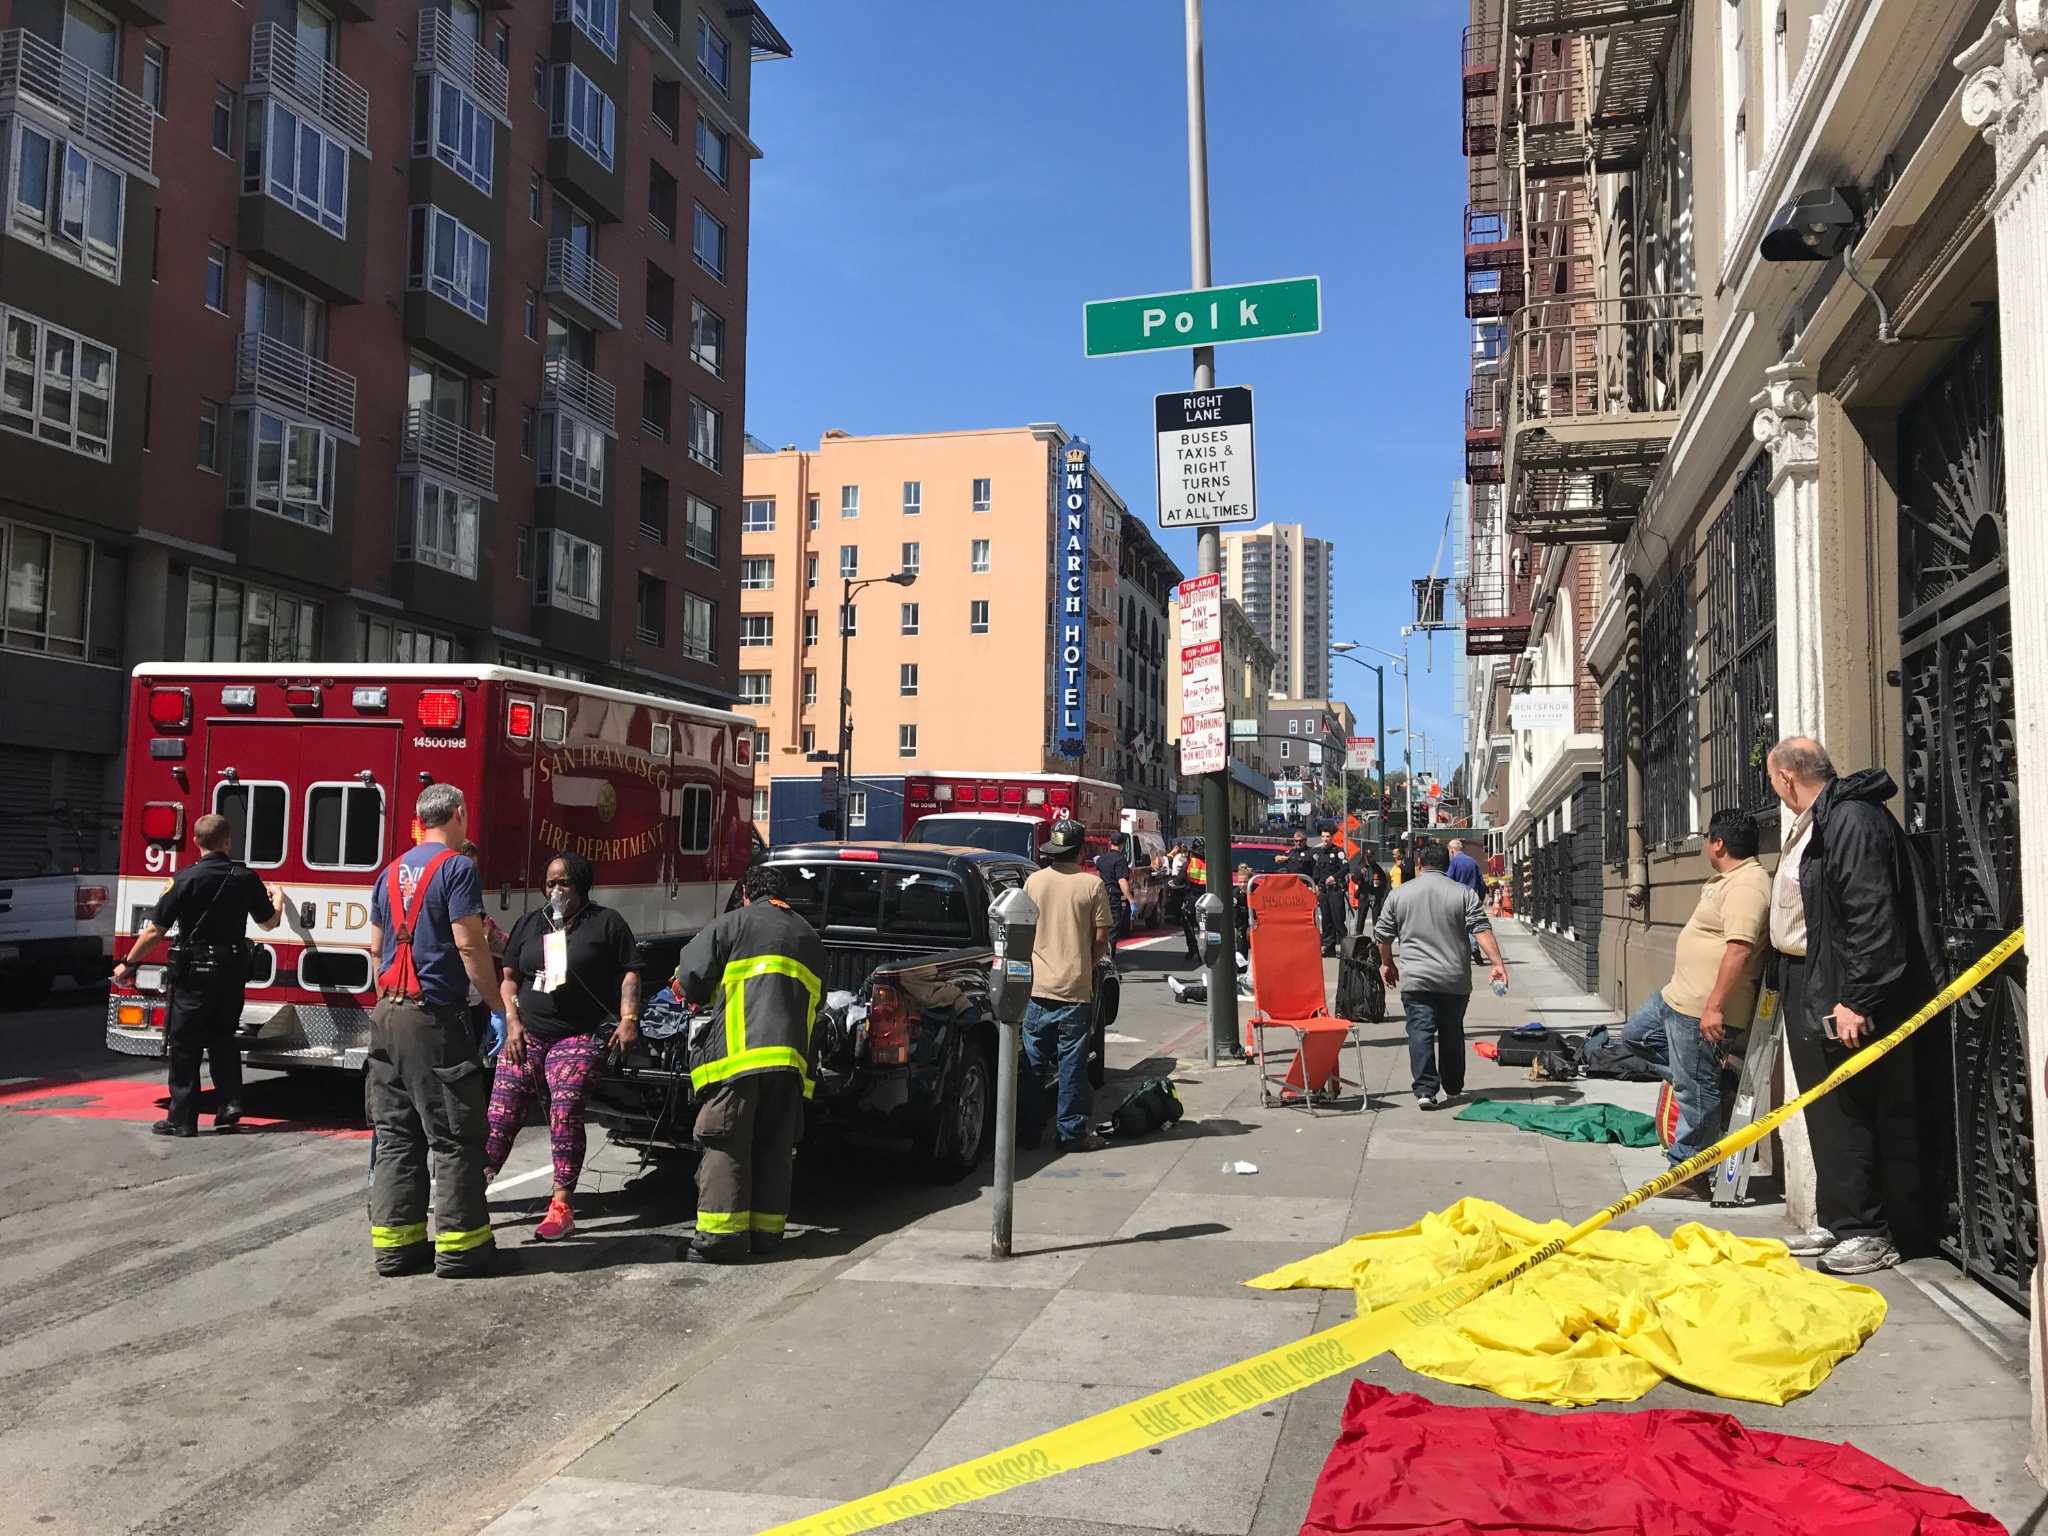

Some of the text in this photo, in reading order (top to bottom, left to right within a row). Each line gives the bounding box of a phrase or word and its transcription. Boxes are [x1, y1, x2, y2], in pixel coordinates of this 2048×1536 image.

[1143, 299, 1259, 337] Polk
[1183, 395, 1223, 409] RIGHT
[1186, 408, 1222, 423] LANE
[1181, 431, 1228, 445] BUSES
[1177, 444, 1234, 460] TAXIS &
[1065, 463, 1085, 472] THE
[1184, 461, 1227, 475] RIGHT
[1182, 476, 1230, 490] TURNS
[1187, 491, 1226, 505] ONLY
[1167, 504, 1249, 521] AT ALL TIMES
[1063, 474, 1083, 728] MONARCH HOTEL
[1192, 606, 1207, 620] ANY
[1192, 618, 1209, 632] TIME
[1182, 659, 1193, 673] NO
[1182, 717, 1194, 733] NO
[1195, 717, 1223, 732] PARKING
[412, 737, 467, 749] 14500198
[540, 744, 670, 792] SAN FRANCISCO
[1051, 807, 1070, 820] 79
[538, 818, 664, 861] FIRE DEPARTMENT
[145, 843, 177, 873] 91
[327, 902, 368, 930] FD
